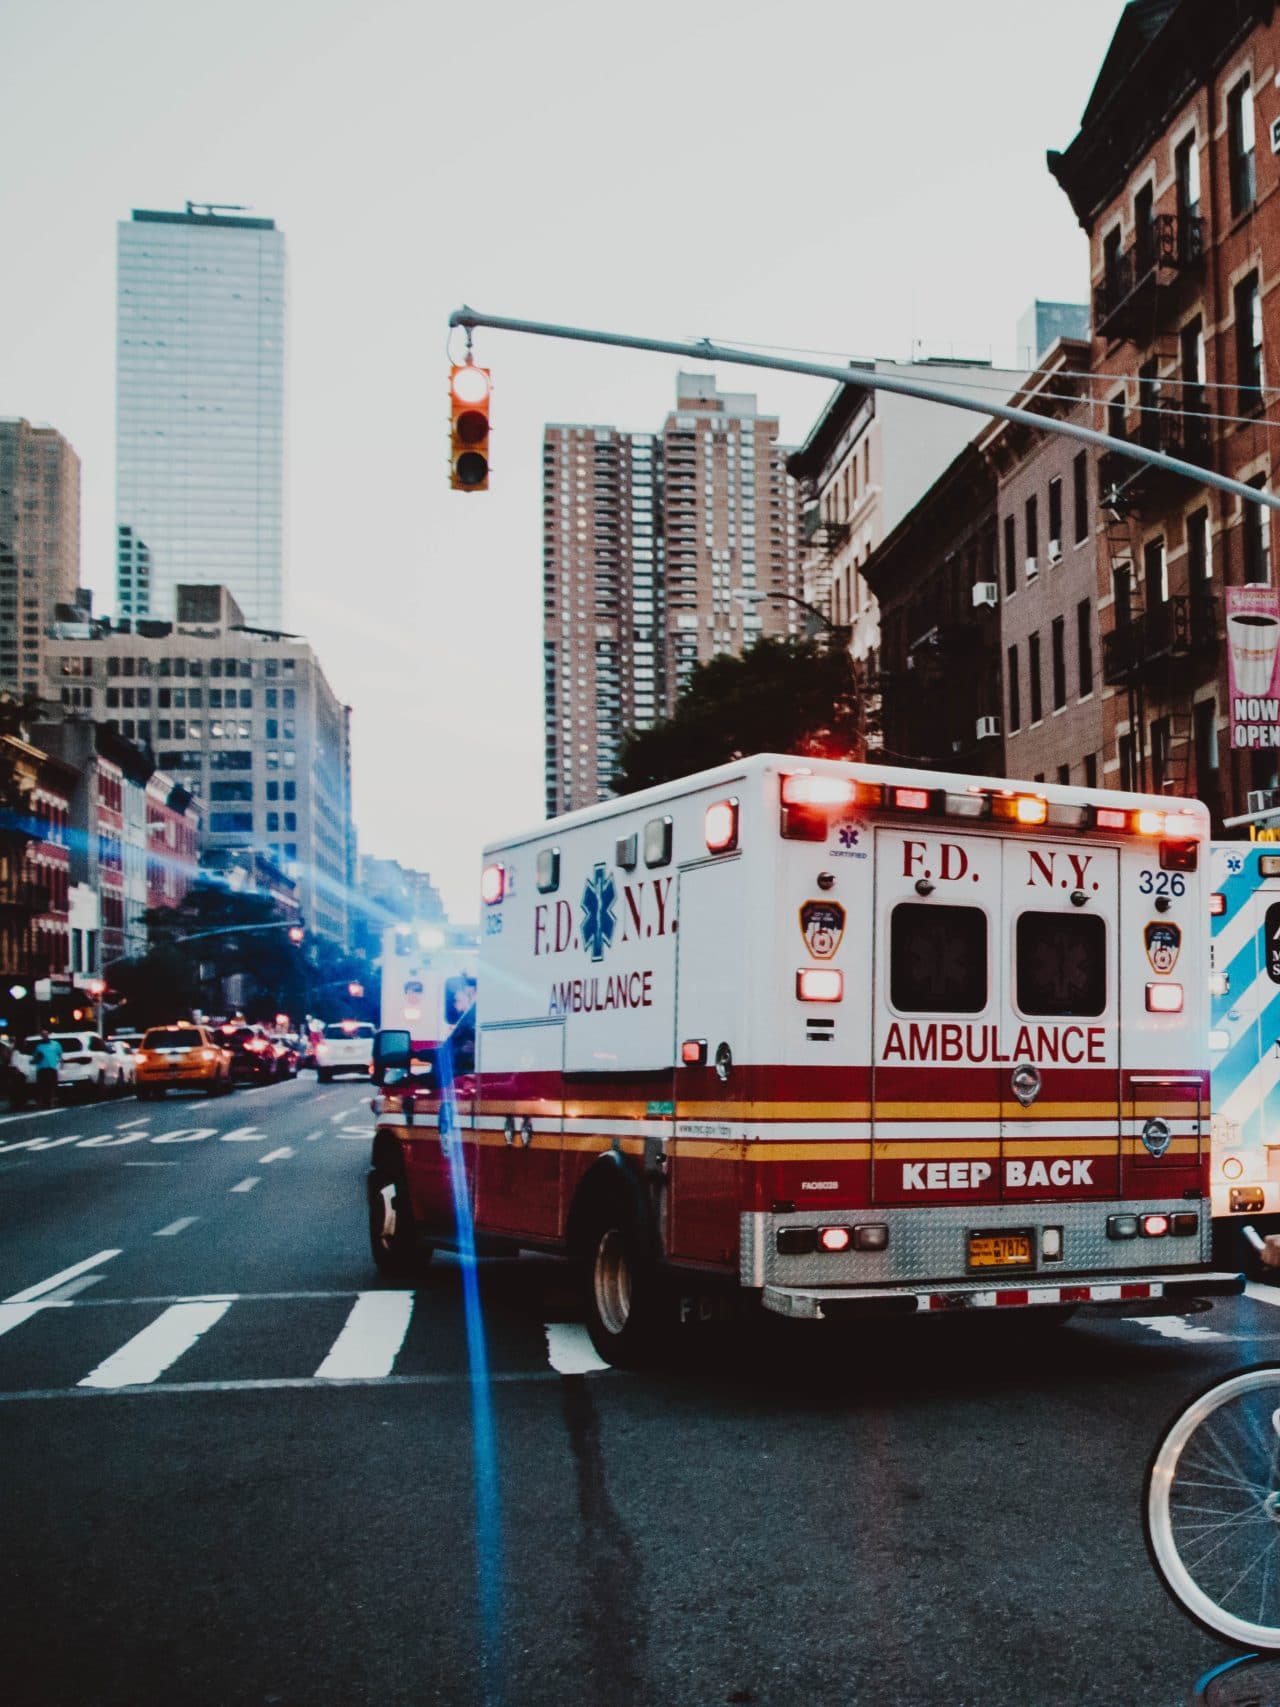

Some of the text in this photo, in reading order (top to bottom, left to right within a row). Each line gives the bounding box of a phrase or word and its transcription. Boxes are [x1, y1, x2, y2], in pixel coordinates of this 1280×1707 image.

[1234, 698, 1279, 721] NOW
[1234, 725, 1280, 748] OPEN
[902, 840, 1099, 891] F.D. N.Y.
[1139, 870, 1186, 896] 326
[534, 876, 679, 956] F.D. N.Y.
[549, 970, 653, 1015] AMBULANCE
[882, 1022, 1106, 1063] AMBULANCE
[902, 1159, 1094, 1190] KEEP BACK
